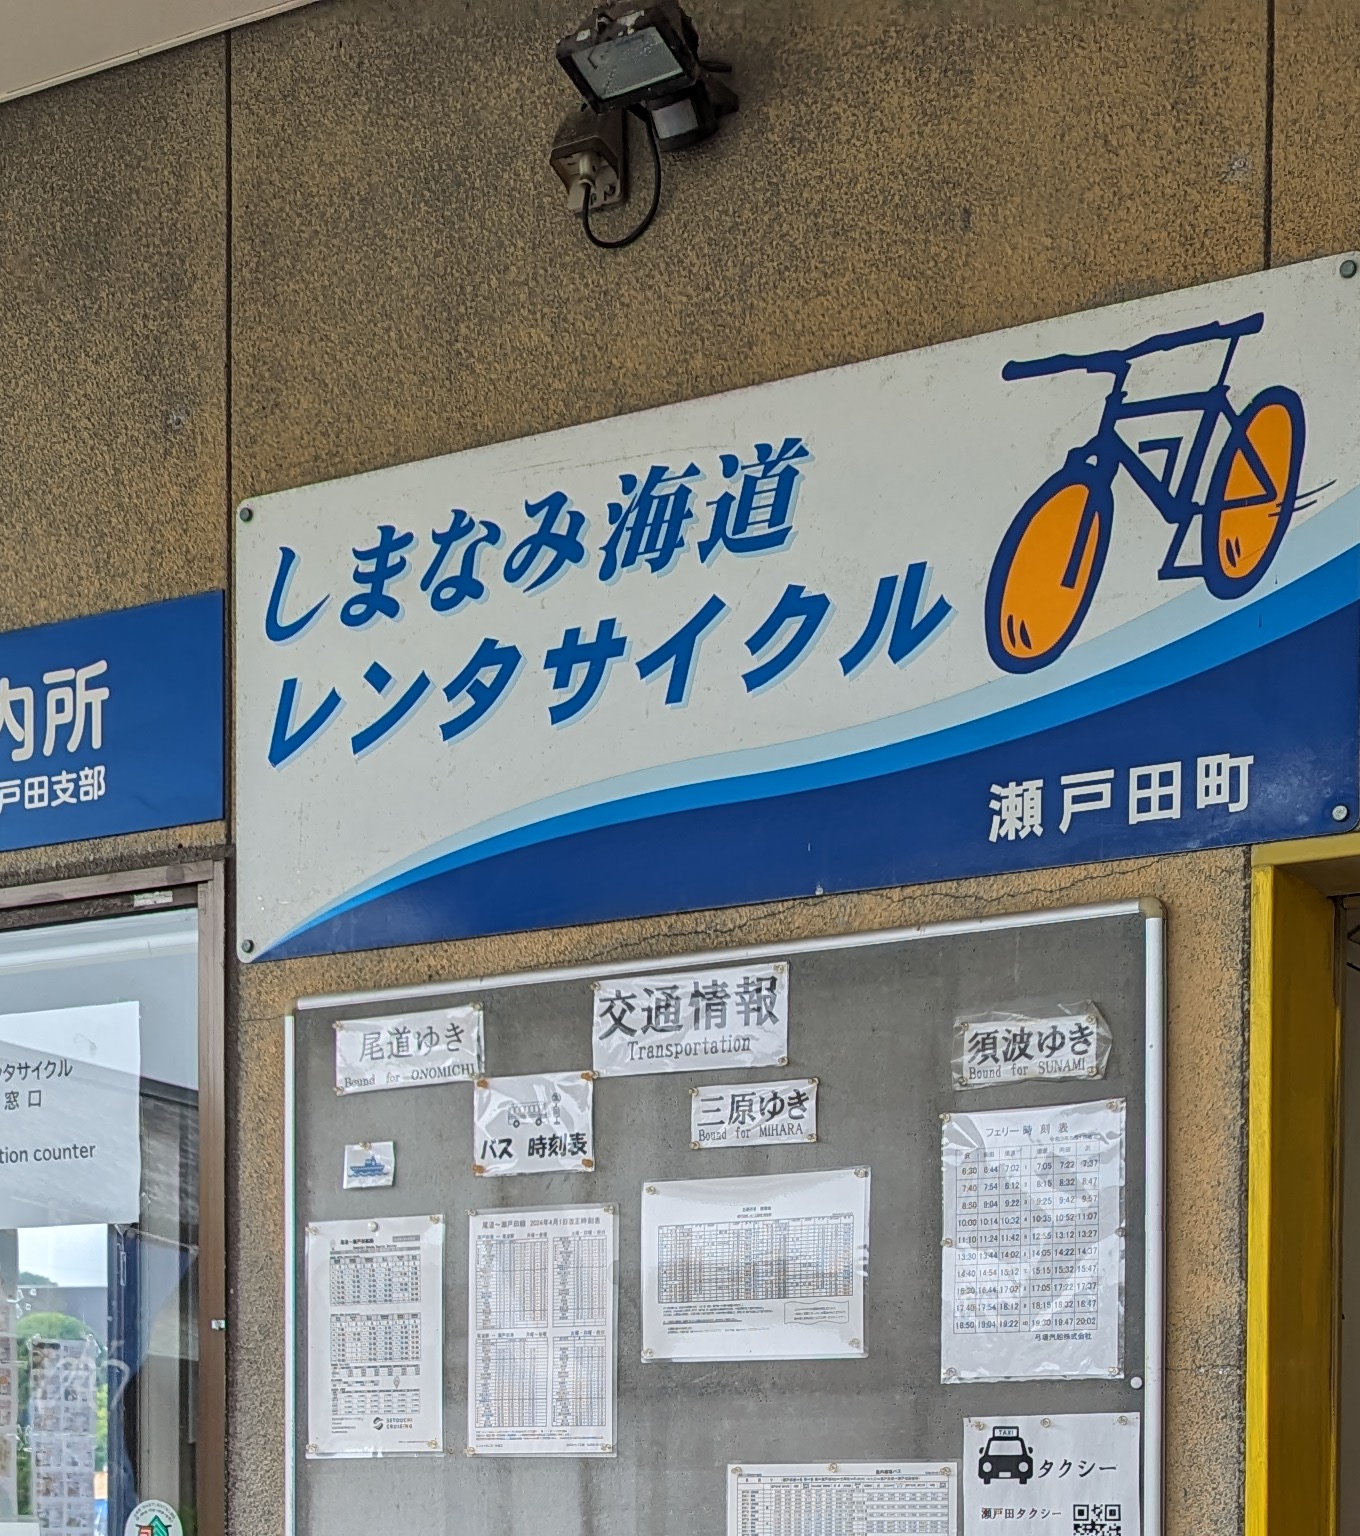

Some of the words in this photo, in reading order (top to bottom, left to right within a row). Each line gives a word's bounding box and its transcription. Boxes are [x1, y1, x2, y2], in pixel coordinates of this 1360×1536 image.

[263, 435, 812, 645] しまなみ海道
[265, 560, 954, 773] レンタサイクル
[987, 751, 1258, 846] 瀬戸田町
[598, 975, 780, 1041] 交通情報
[359, 1022, 466, 1063] 尾道ゆき
[628, 1034, 752, 1062] Transportation
[967, 1022, 1096, 1066] 須波ゆき
[385, 1071, 401, 1084] for
[411, 1062, 476, 1081] ONOMICHI
[968, 1064, 1002, 1081] Bound
[1011, 1062, 1029, 1077] for
[1037, 1056, 1086, 1074] SUNAMI
[696, 1089, 811, 1128] 三原ゆき
[481, 1137, 514, 1160] バス
[528, 1132, 588, 1159] 時刻表
[698, 1127, 729, 1143] Bound
[735, 1125, 754, 1140] for
[759, 1121, 804, 1139] MIHARA
[33, 1142, 96, 1163] counter
[1038, 1459, 1117, 1479] タクシー
[981, 1507, 1062, 1521] 瀬戸田タクシー
